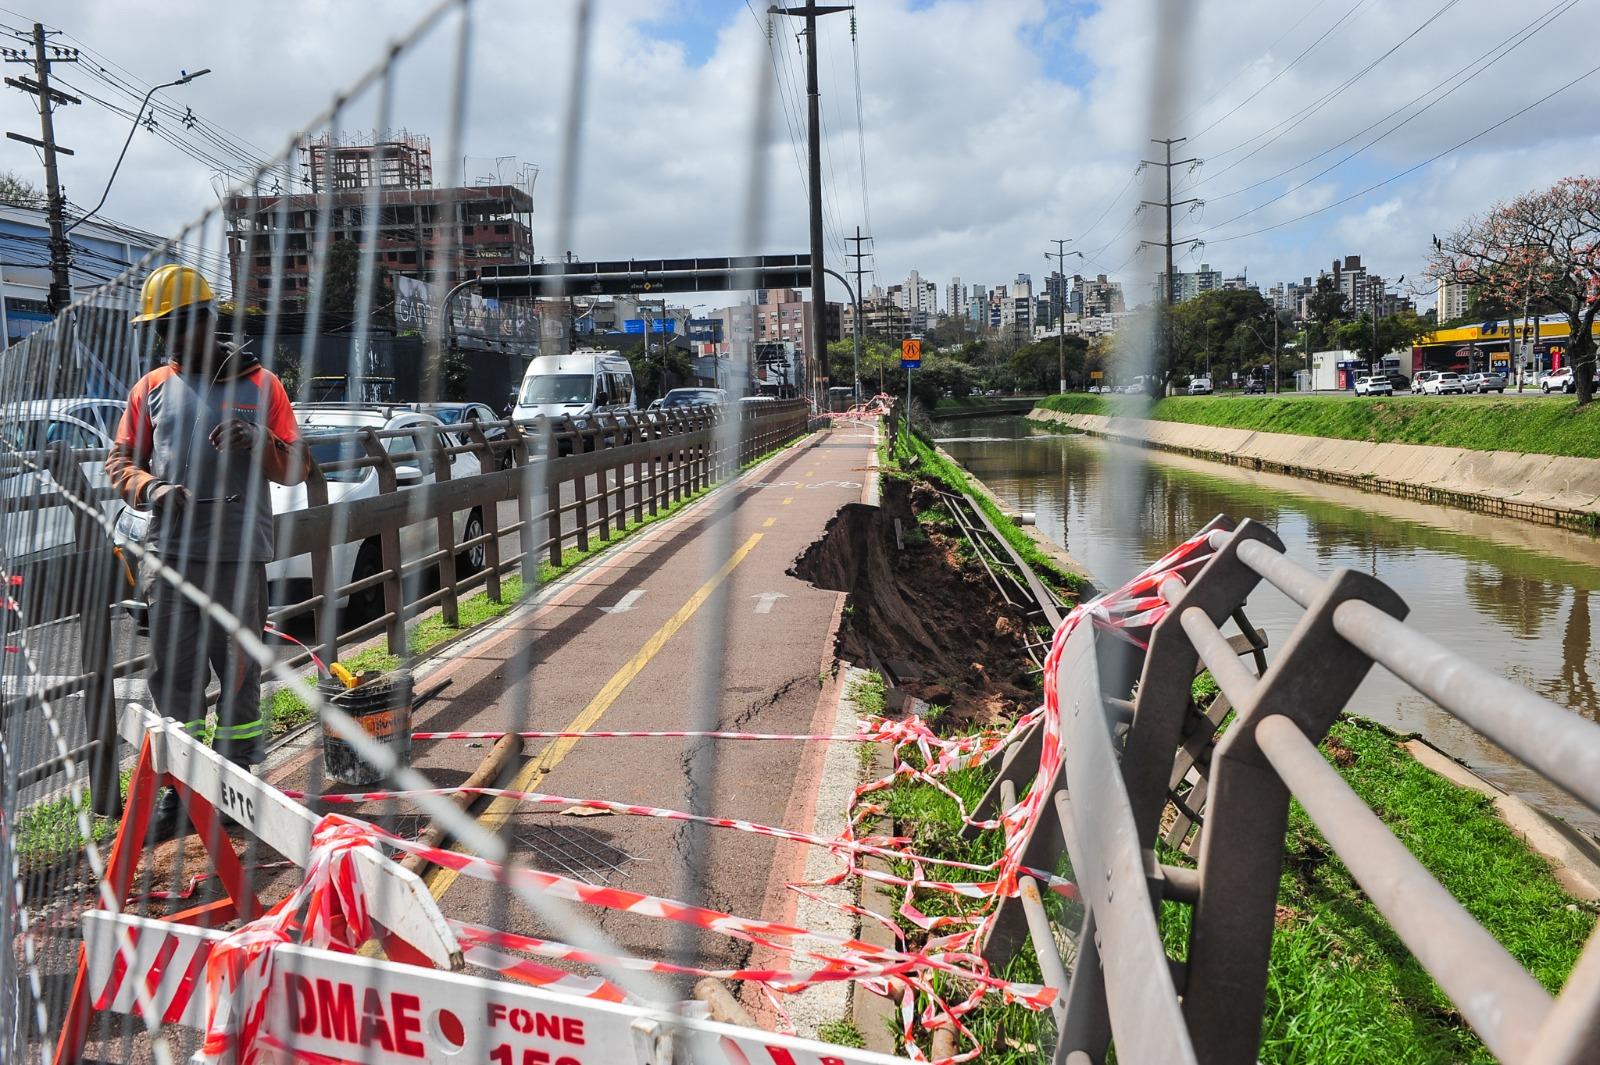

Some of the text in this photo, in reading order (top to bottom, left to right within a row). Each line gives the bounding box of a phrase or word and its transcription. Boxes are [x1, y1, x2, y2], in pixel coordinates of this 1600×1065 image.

[220, 781, 256, 825] EPTC
[284, 972, 425, 1058] DMAE
[487, 1002, 585, 1046] FONE
